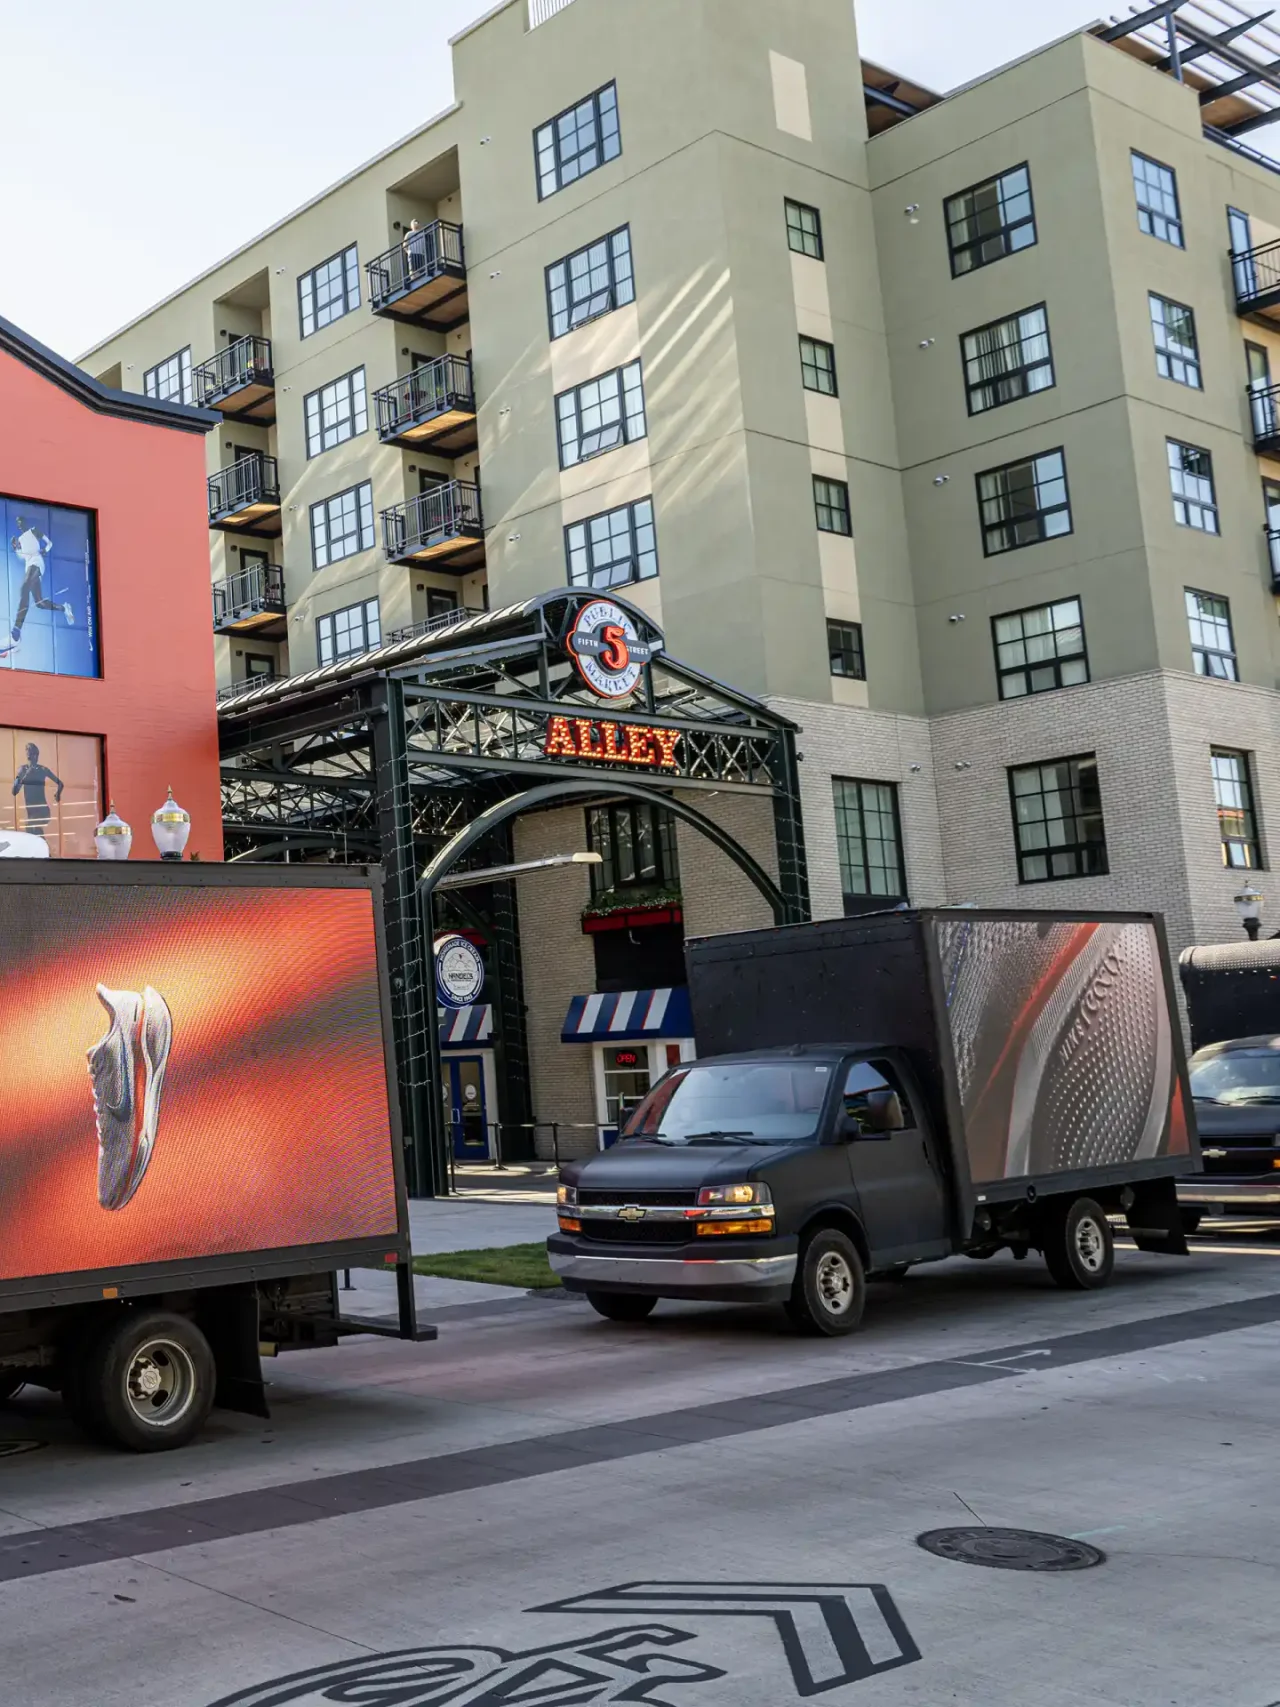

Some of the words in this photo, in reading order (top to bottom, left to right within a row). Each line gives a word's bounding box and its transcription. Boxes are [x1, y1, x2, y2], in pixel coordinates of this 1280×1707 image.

[578, 637, 599, 648] FIFTH
[626, 645, 649, 655] STREET
[601, 626, 629, 670] 5
[585, 661, 636, 692] MARKET
[545, 716, 680, 767] ALLEY
[616, 1053, 635, 1063] OPEN
